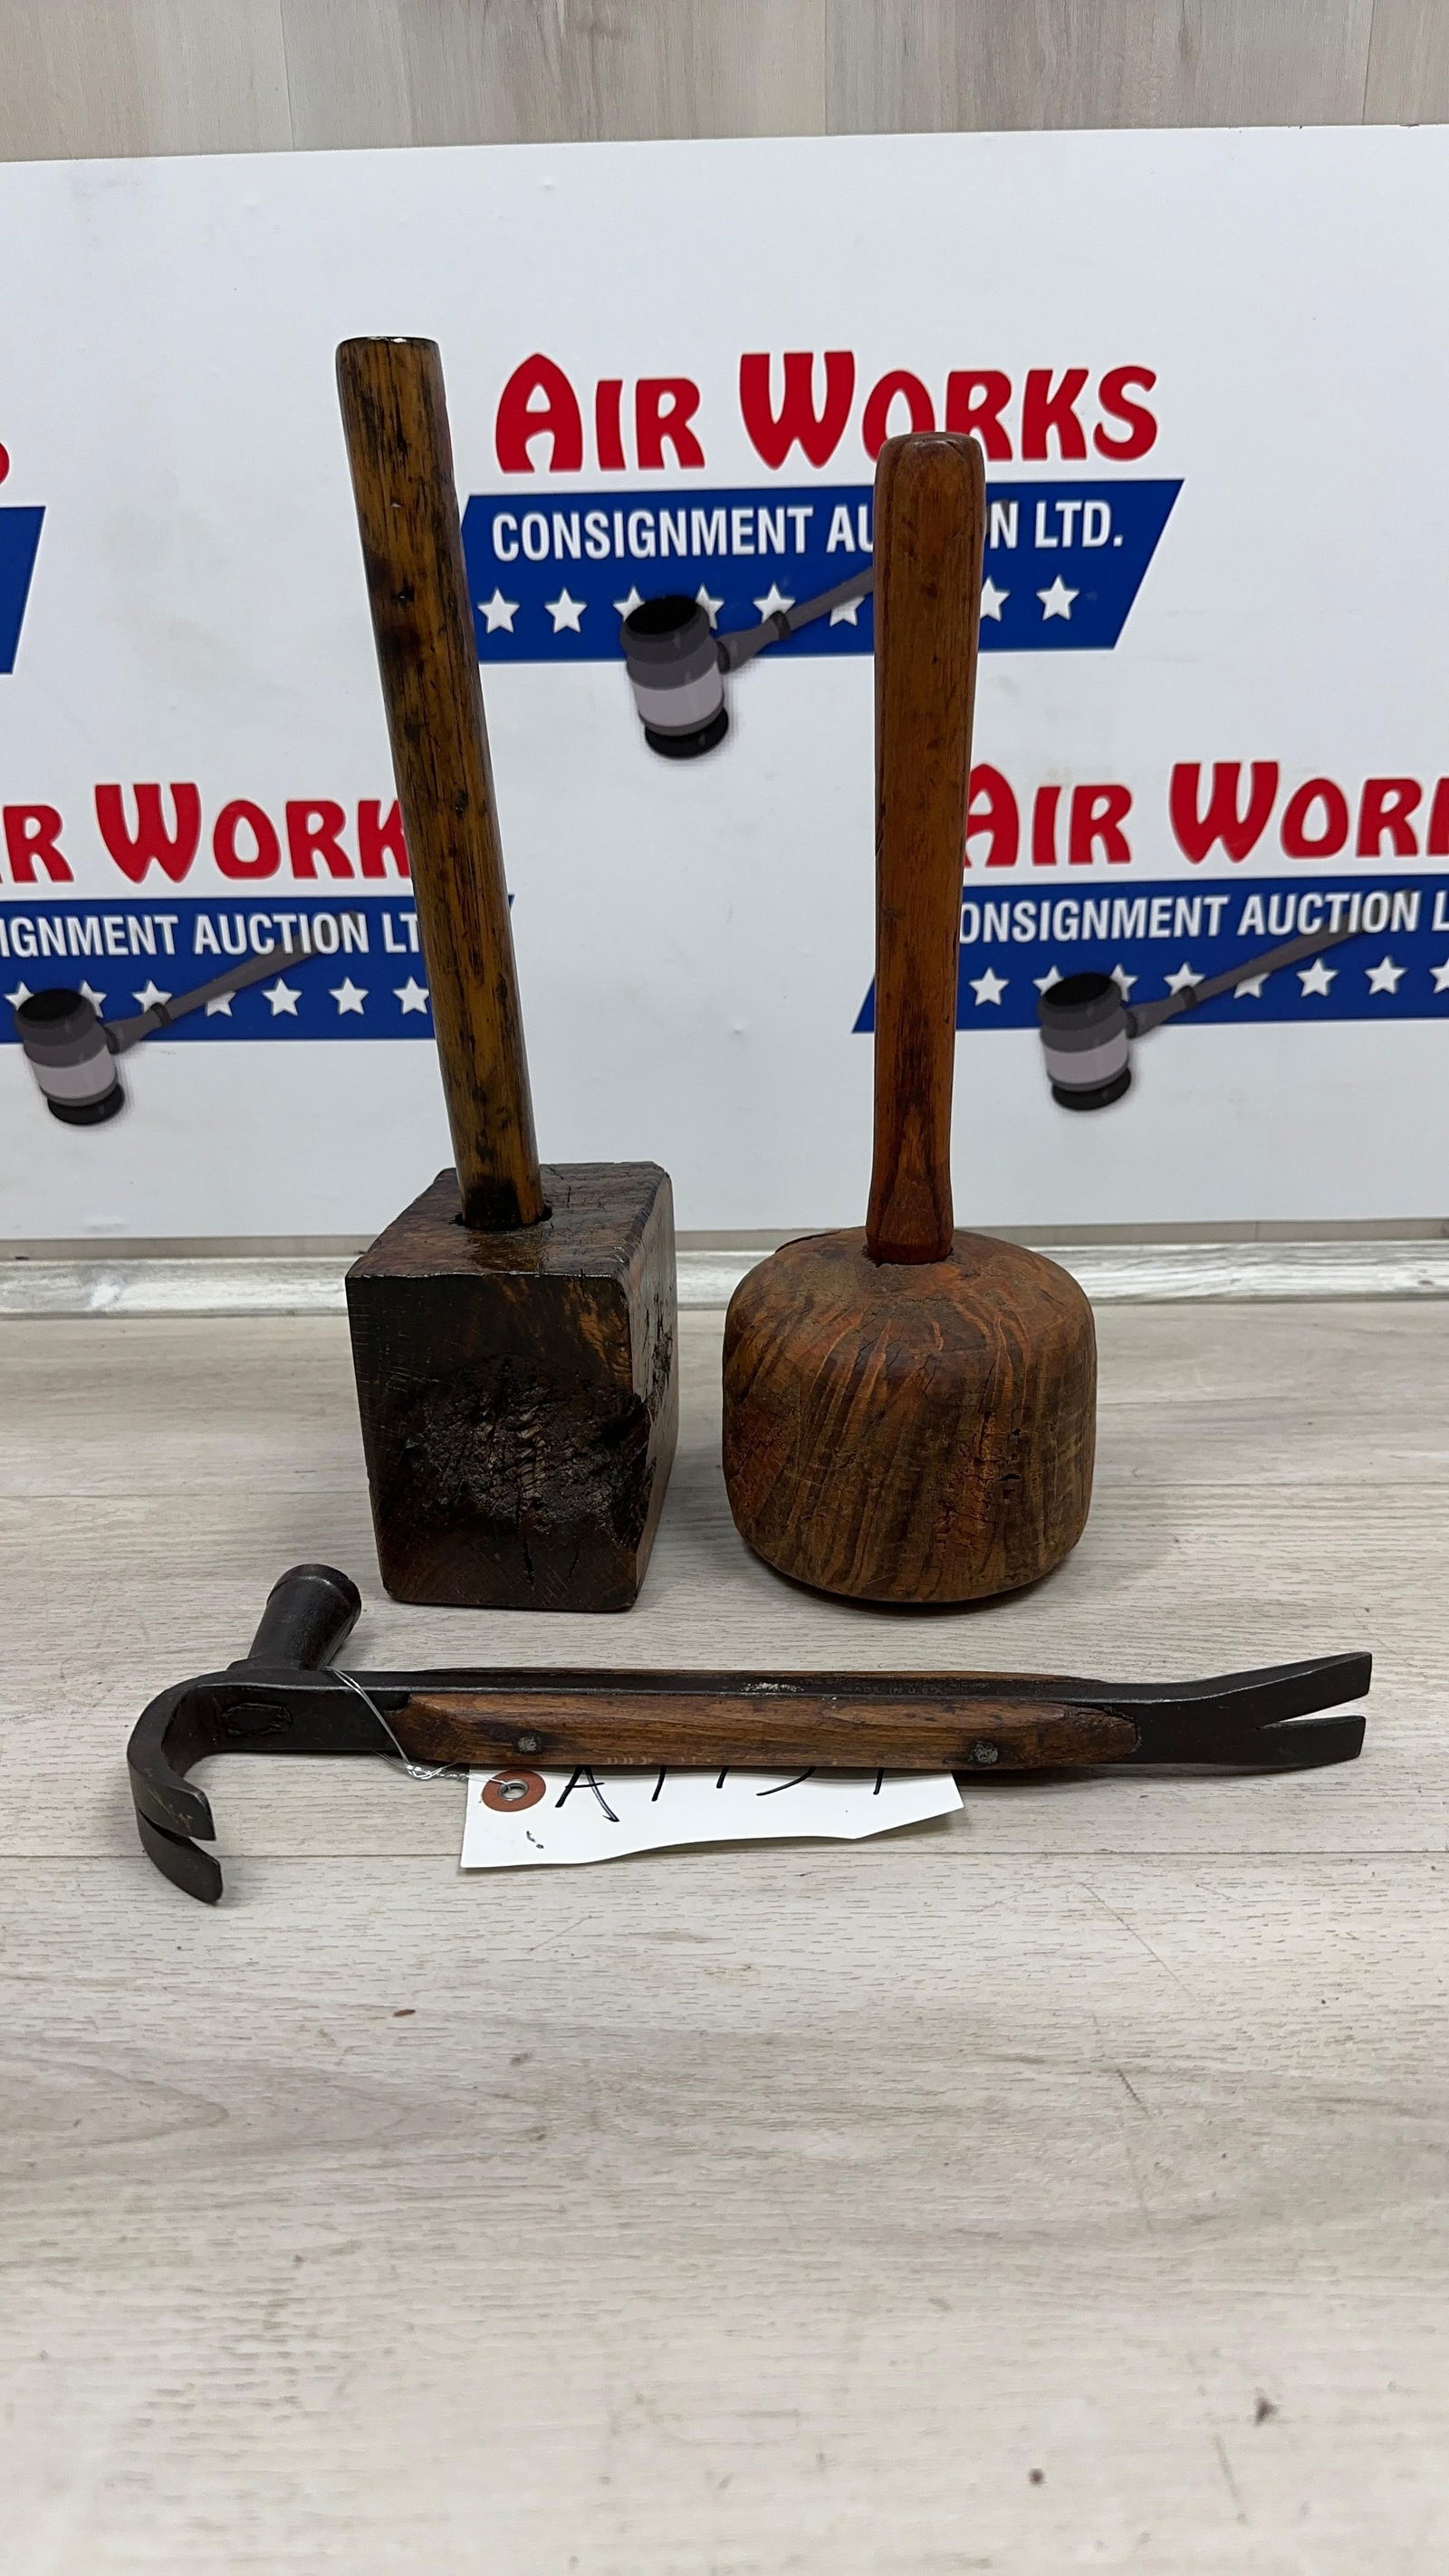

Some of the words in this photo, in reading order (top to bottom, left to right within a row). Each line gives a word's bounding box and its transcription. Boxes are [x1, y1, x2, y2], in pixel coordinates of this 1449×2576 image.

[495, 354, 705, 472] AIR
[739, 351, 1157, 468] WORKS
[493, 507, 813, 562] CONSIGNMENT
[1035, 501, 1123, 548] LTD.
[194, 913, 369, 955] AUCTION
[1237, 890, 1422, 937] AUCTION
